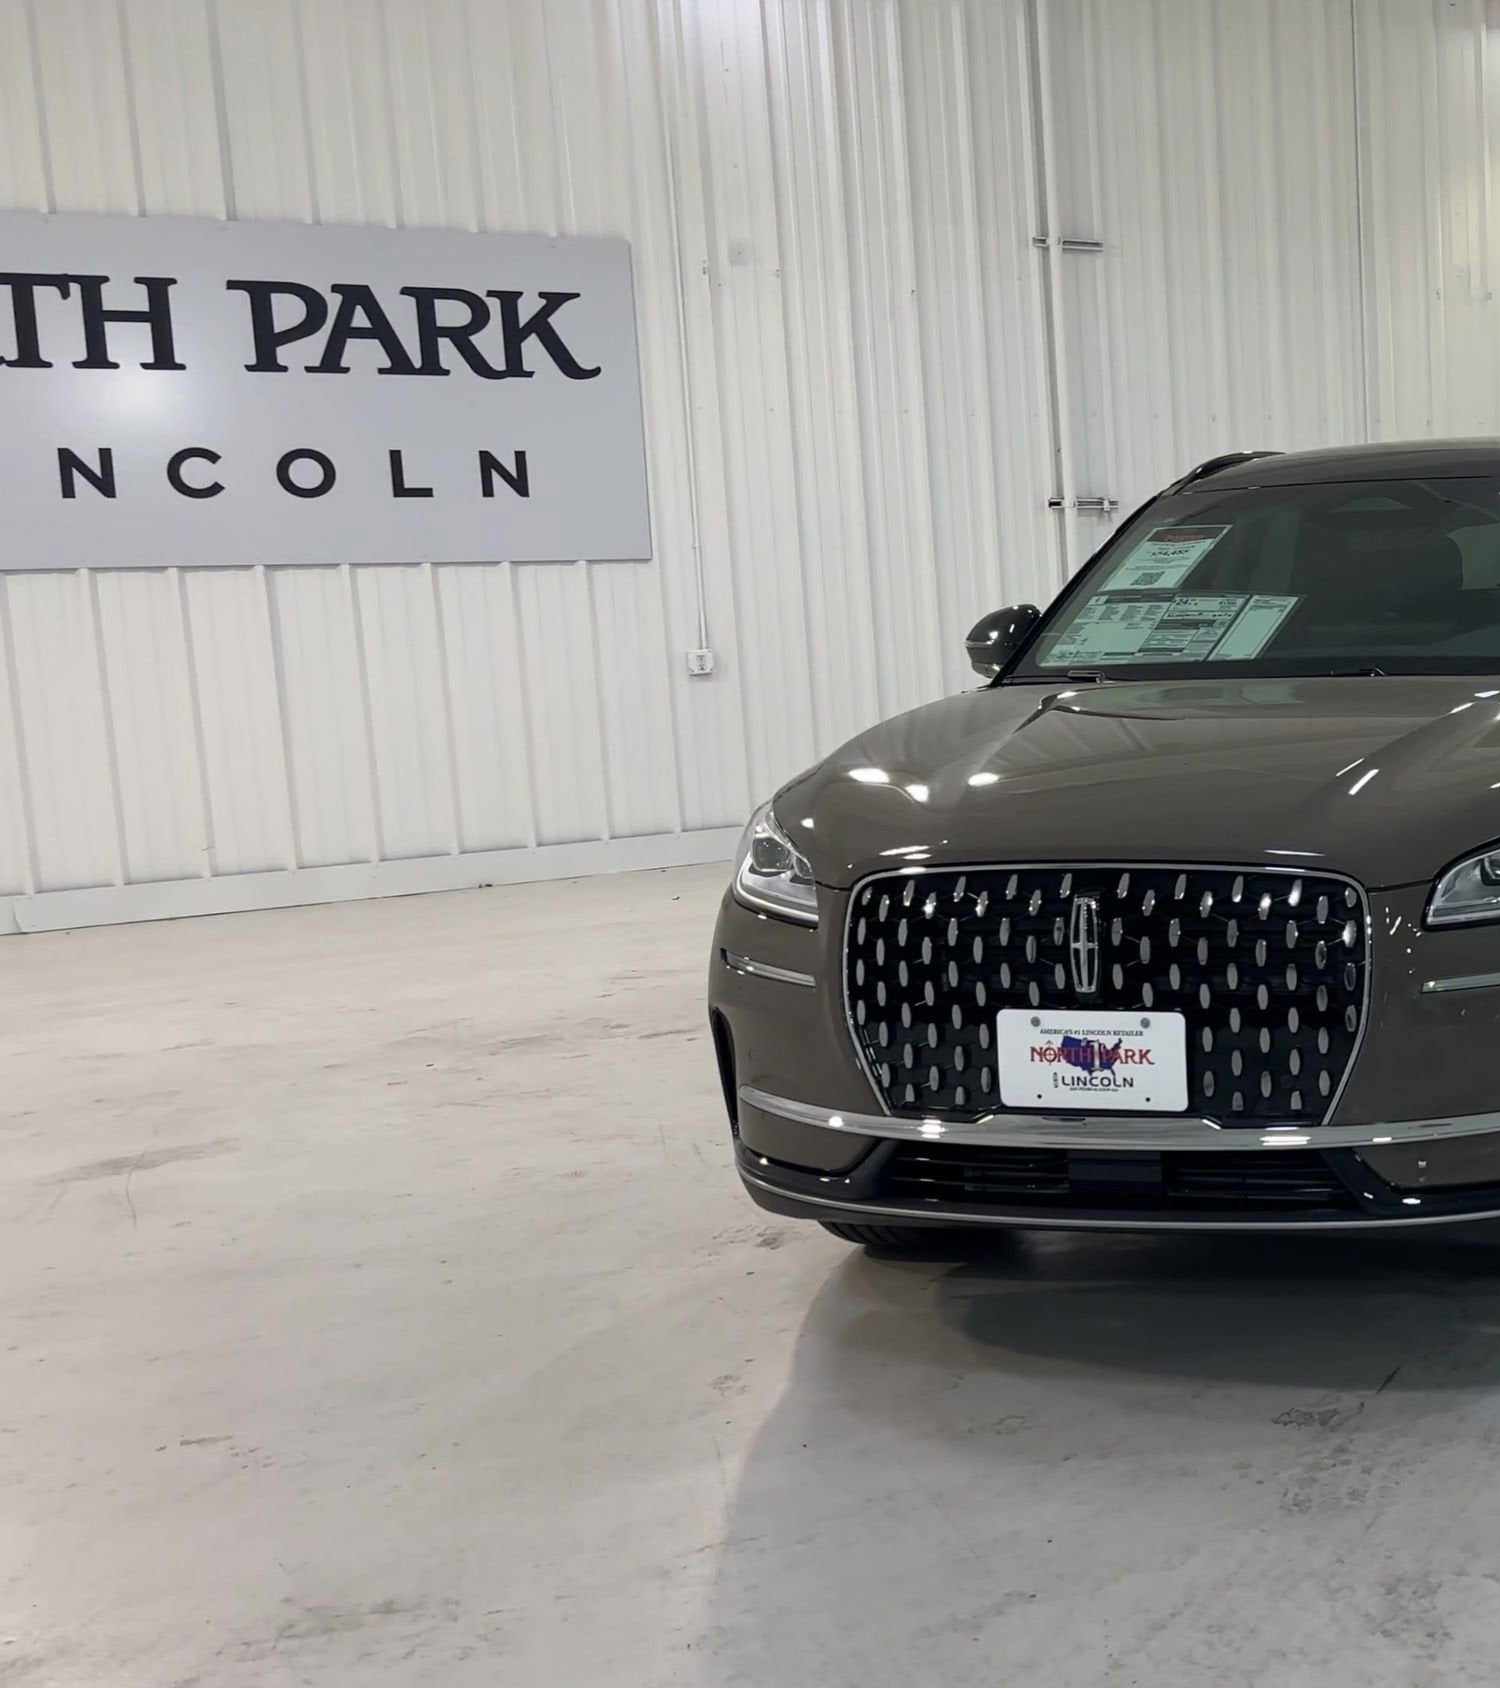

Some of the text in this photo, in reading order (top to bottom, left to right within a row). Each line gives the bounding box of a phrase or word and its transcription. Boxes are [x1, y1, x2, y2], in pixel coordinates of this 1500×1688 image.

[0, 273, 602, 380] TH PARK
[1030, 1046, 1155, 1065] NORTH PARK
[1061, 1075, 1134, 1088] LINCOLN
